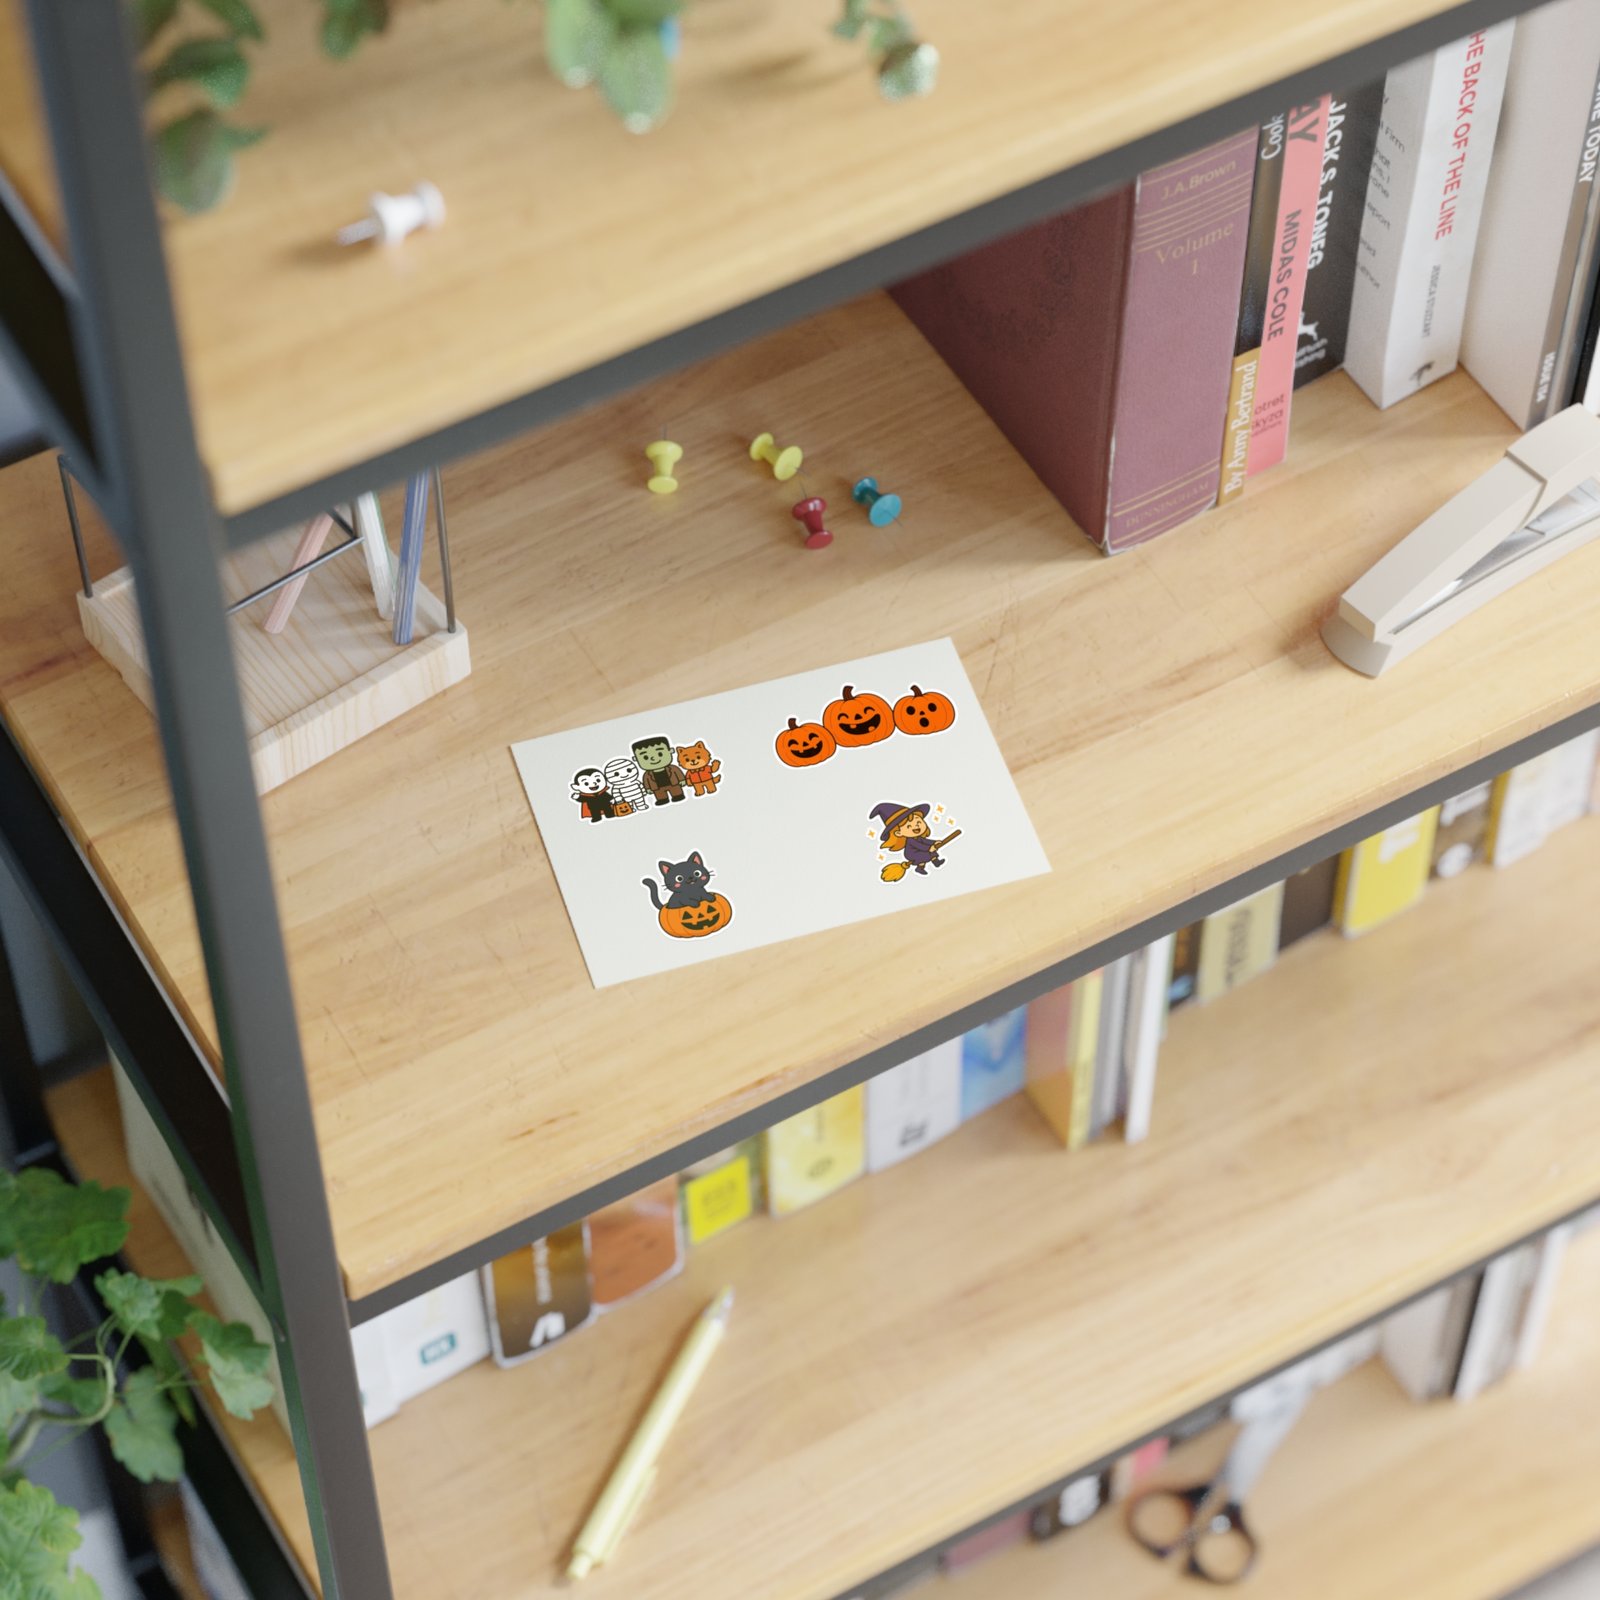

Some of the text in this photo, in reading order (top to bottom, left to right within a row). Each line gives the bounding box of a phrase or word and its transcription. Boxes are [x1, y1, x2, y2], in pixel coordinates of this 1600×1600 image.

[1457, 61, 1481, 120] BACK
[1261, 112, 1285, 160] Cook
[1323, 101, 1347, 167] JACK
[1451, 122, 1471, 150] OF
[1443, 151, 1466, 196] THE
[1434, 195, 1458, 241] LINE
[1156, 223, 1234, 265] Volume
[1267, 209, 1301, 342] MIDAS COLE
[1231, 359, 1258, 431] Bertrand
[1224, 470, 1247, 496] By
